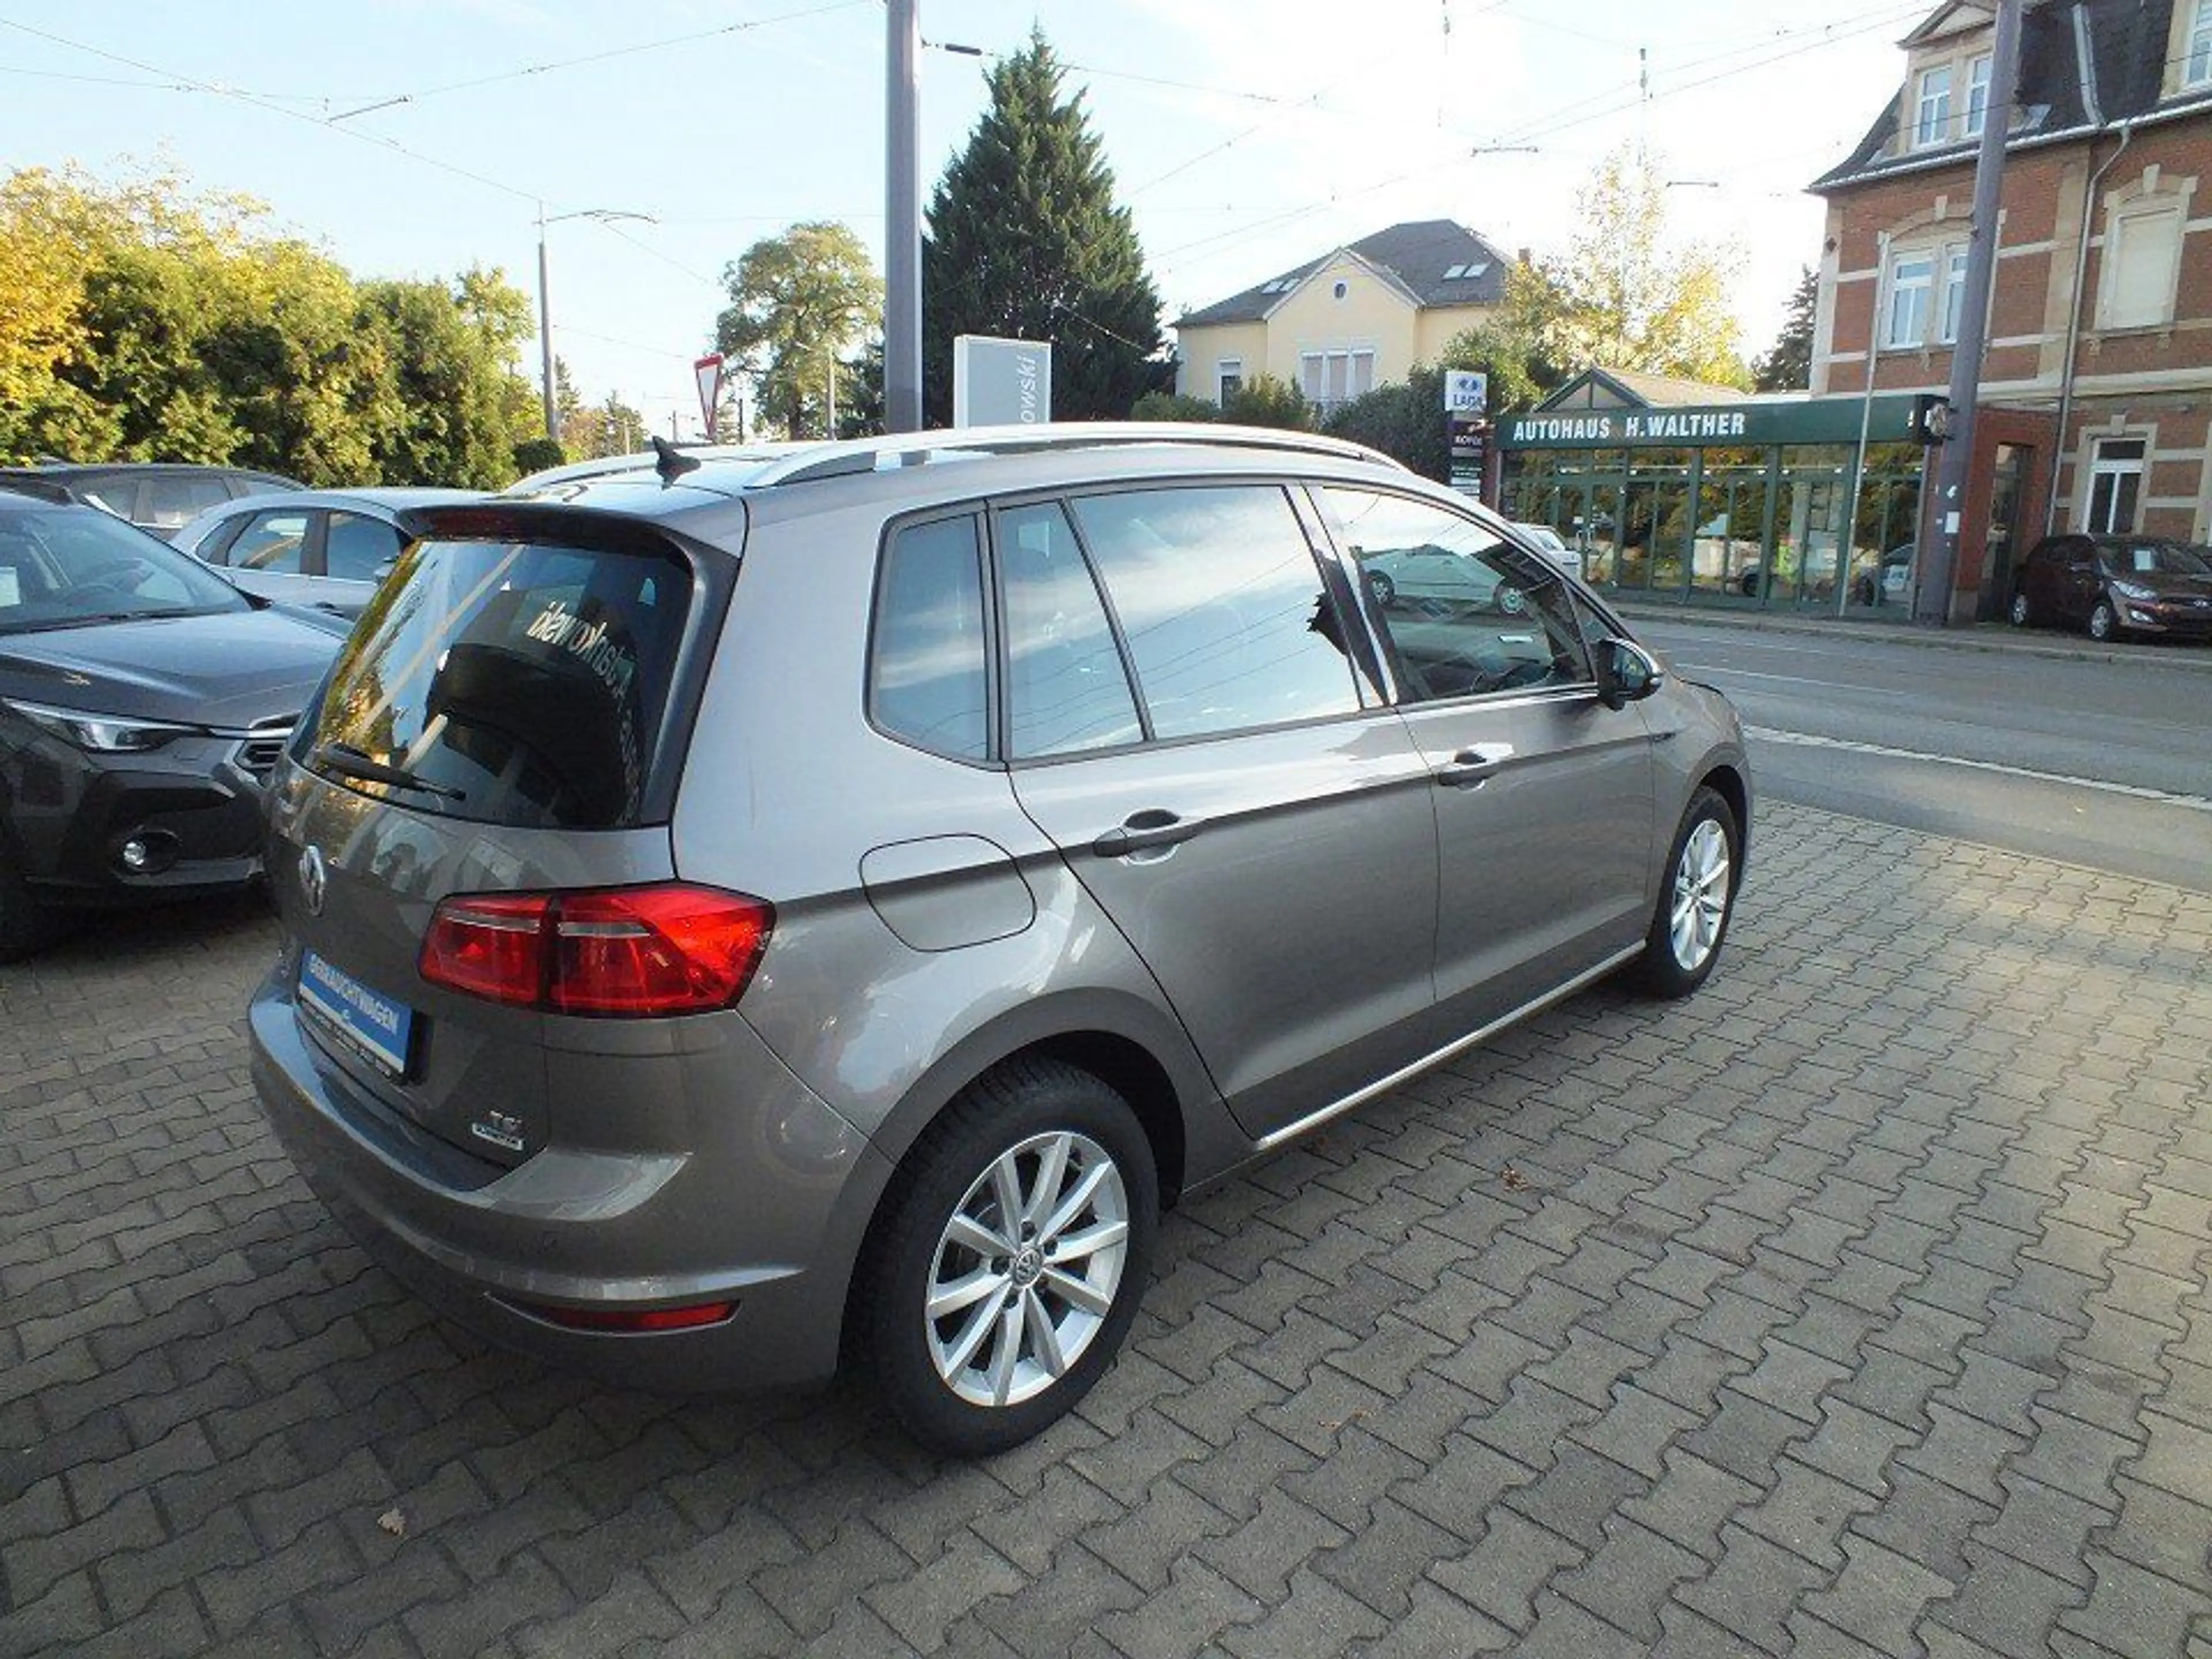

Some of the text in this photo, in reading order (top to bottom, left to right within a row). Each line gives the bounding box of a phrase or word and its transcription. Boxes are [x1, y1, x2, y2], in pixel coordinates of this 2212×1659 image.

[1016, 355, 1036, 423] owski
[1513, 412, 1746, 441] AUTOHAUS H.WALTHER
